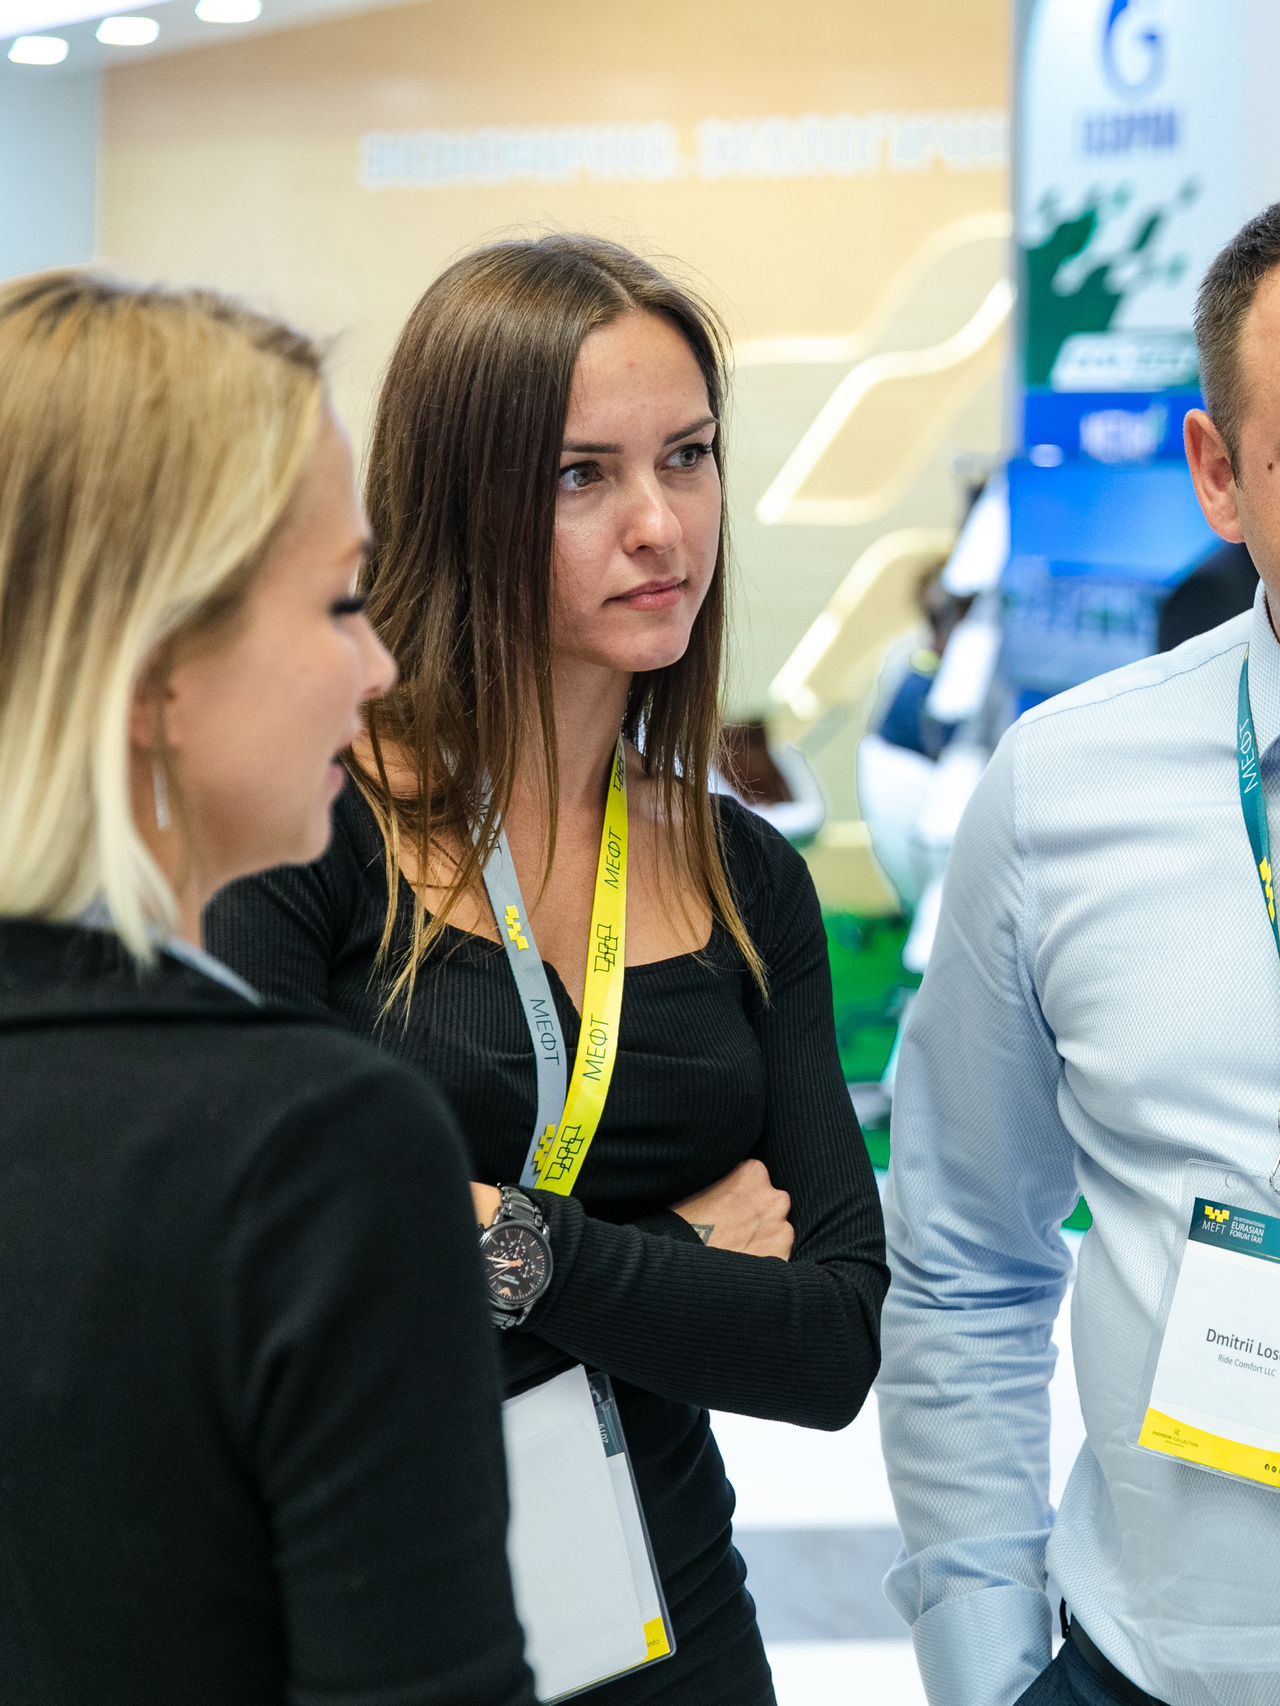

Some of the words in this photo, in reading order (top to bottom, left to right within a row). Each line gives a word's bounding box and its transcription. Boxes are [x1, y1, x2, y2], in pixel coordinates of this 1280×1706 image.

[1238, 718, 1259, 794] МЕФТ
[604, 825, 622, 890] МЕФТ
[529, 998, 560, 1066] МЕФТ
[582, 1012, 609, 1082] МЕФТ
[1202, 1220, 1227, 1235] MEFT
[1229, 1229, 1250, 1241] FORUM
[1250, 1235, 1263, 1245] TAXI
[1231, 1221, 1265, 1237] EURASIAN
[1206, 1328, 1254, 1354] Dmitrii
[1217, 1354, 1233, 1366] Ride
[1234, 1358, 1263, 1374] Comfort
[1264, 1366, 1277, 1377] LLC
